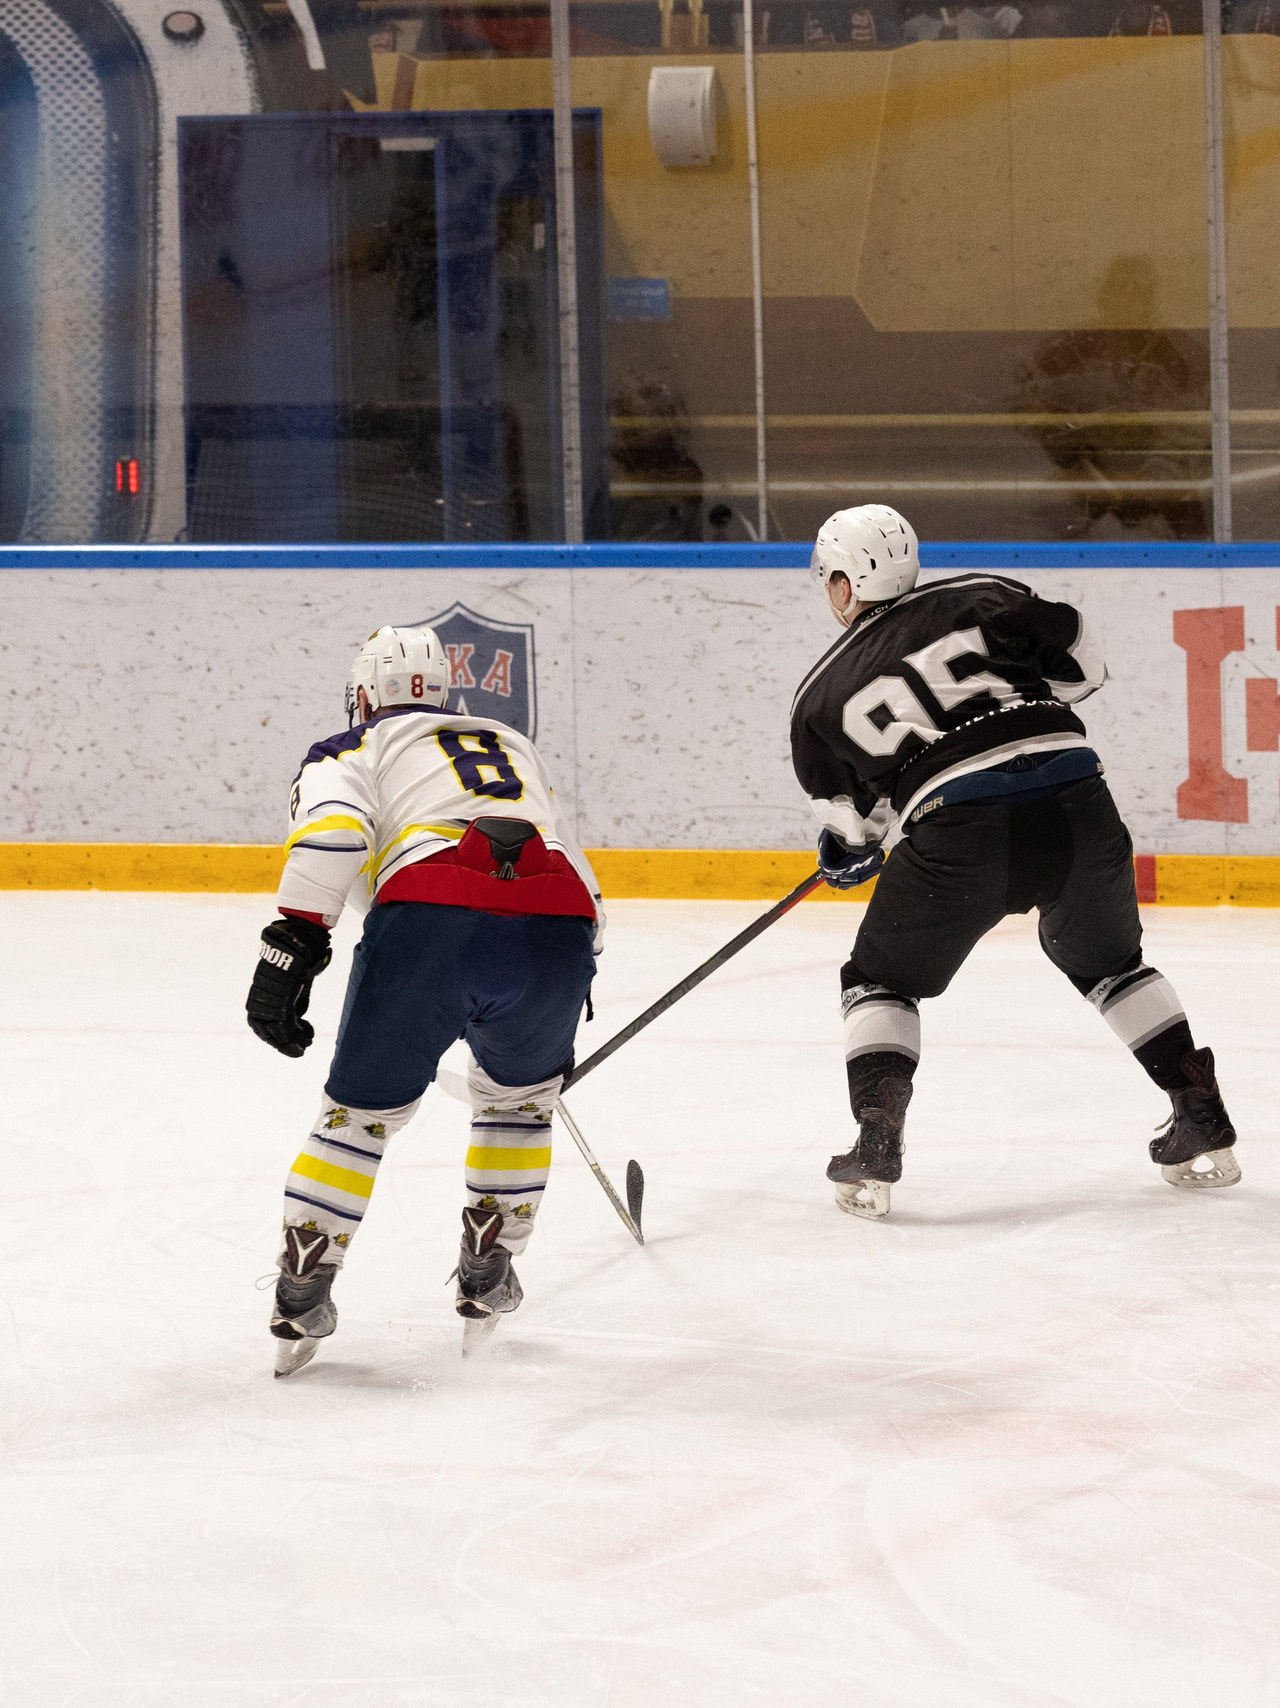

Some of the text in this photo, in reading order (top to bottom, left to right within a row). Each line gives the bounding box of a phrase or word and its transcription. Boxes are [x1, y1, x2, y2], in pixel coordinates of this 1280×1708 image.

[411, 674, 423, 699] 8
[446, 643, 514, 697] KA
[842, 626, 1026, 757] 95
[435, 728, 525, 803] 8
